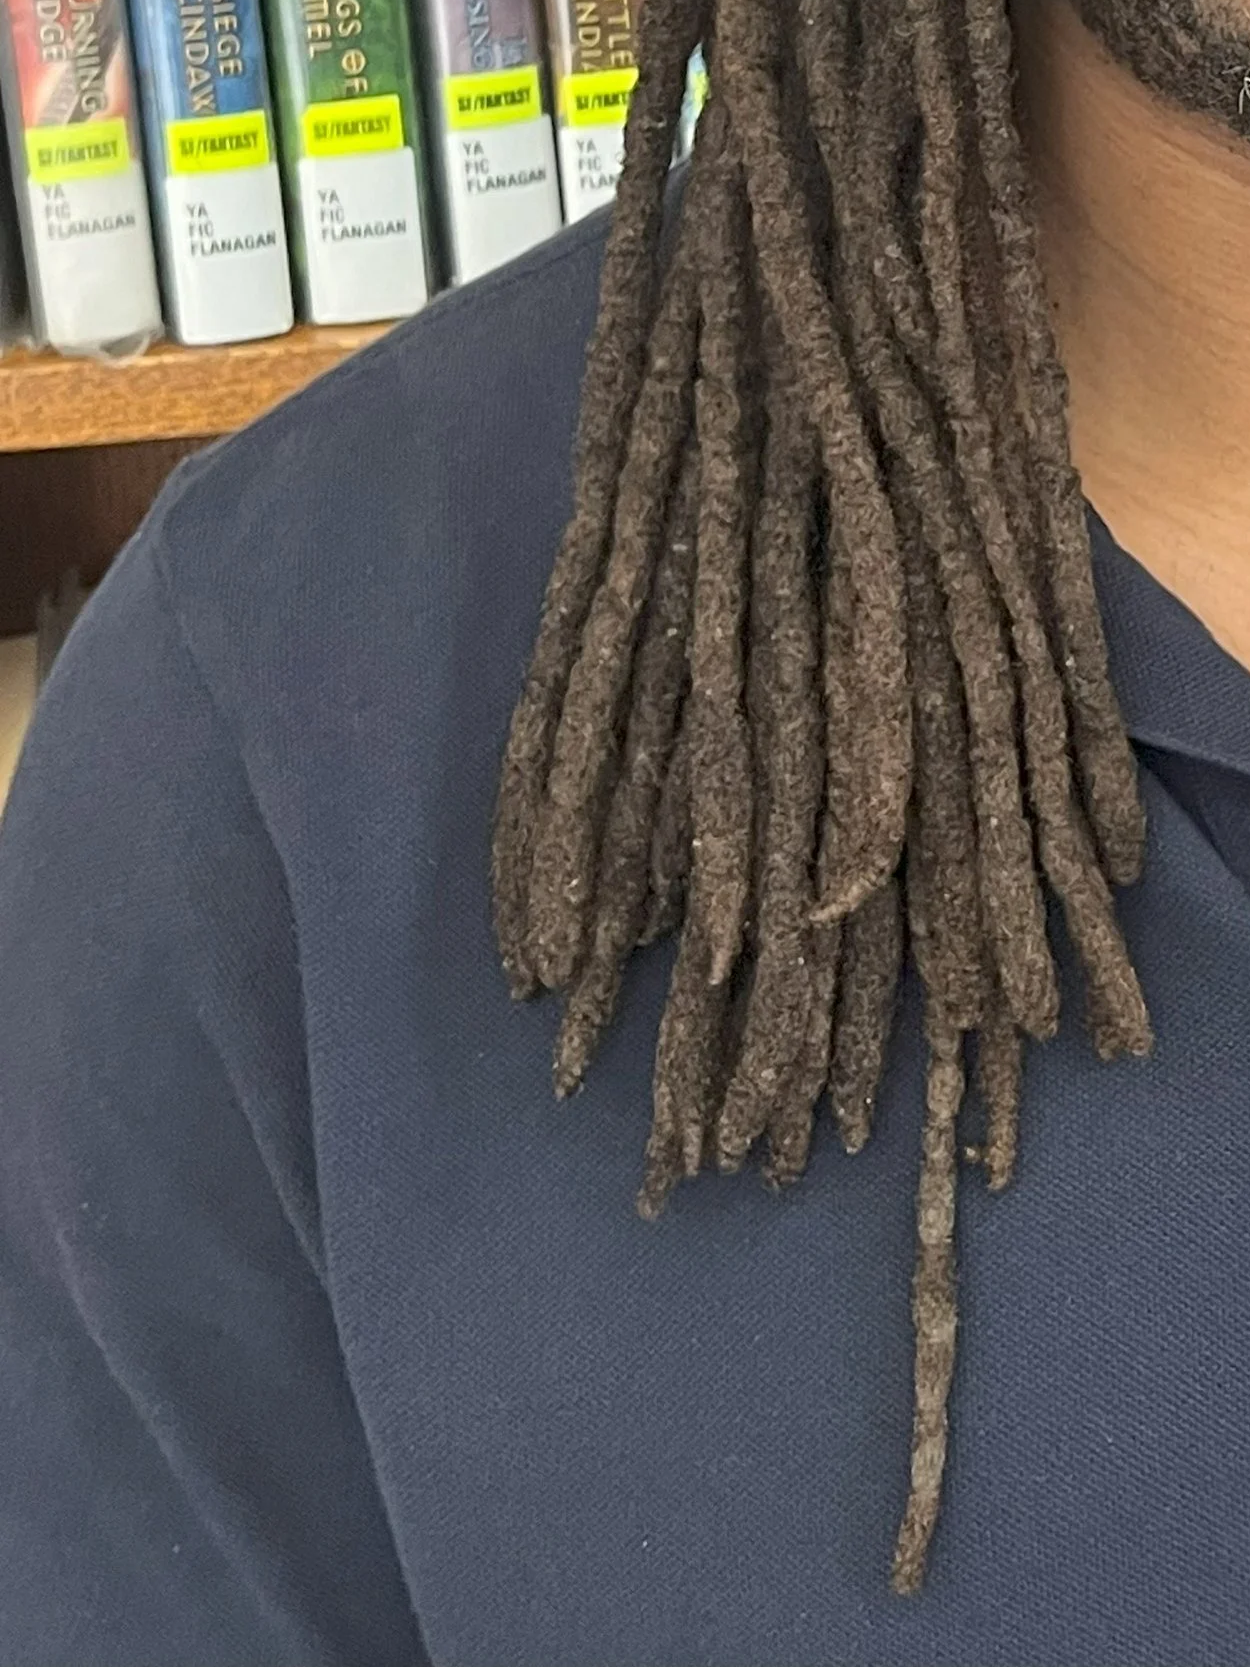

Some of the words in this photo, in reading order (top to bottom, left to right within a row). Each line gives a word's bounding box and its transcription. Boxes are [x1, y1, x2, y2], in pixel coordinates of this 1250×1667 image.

[463, 140, 484, 156] YA
[576, 138, 597, 153] YA
[465, 158, 489, 175] FIC
[578, 156, 602, 171] FIC
[467, 169, 546, 194] FLANAGAN
[318, 188, 340, 205] YA
[186, 202, 208, 219] YA
[320, 207, 344, 224] FIC
[189, 221, 215, 238] FIC
[322, 218, 407, 242] FLANAGAN
[191, 231, 276, 257] FLANAGAN
